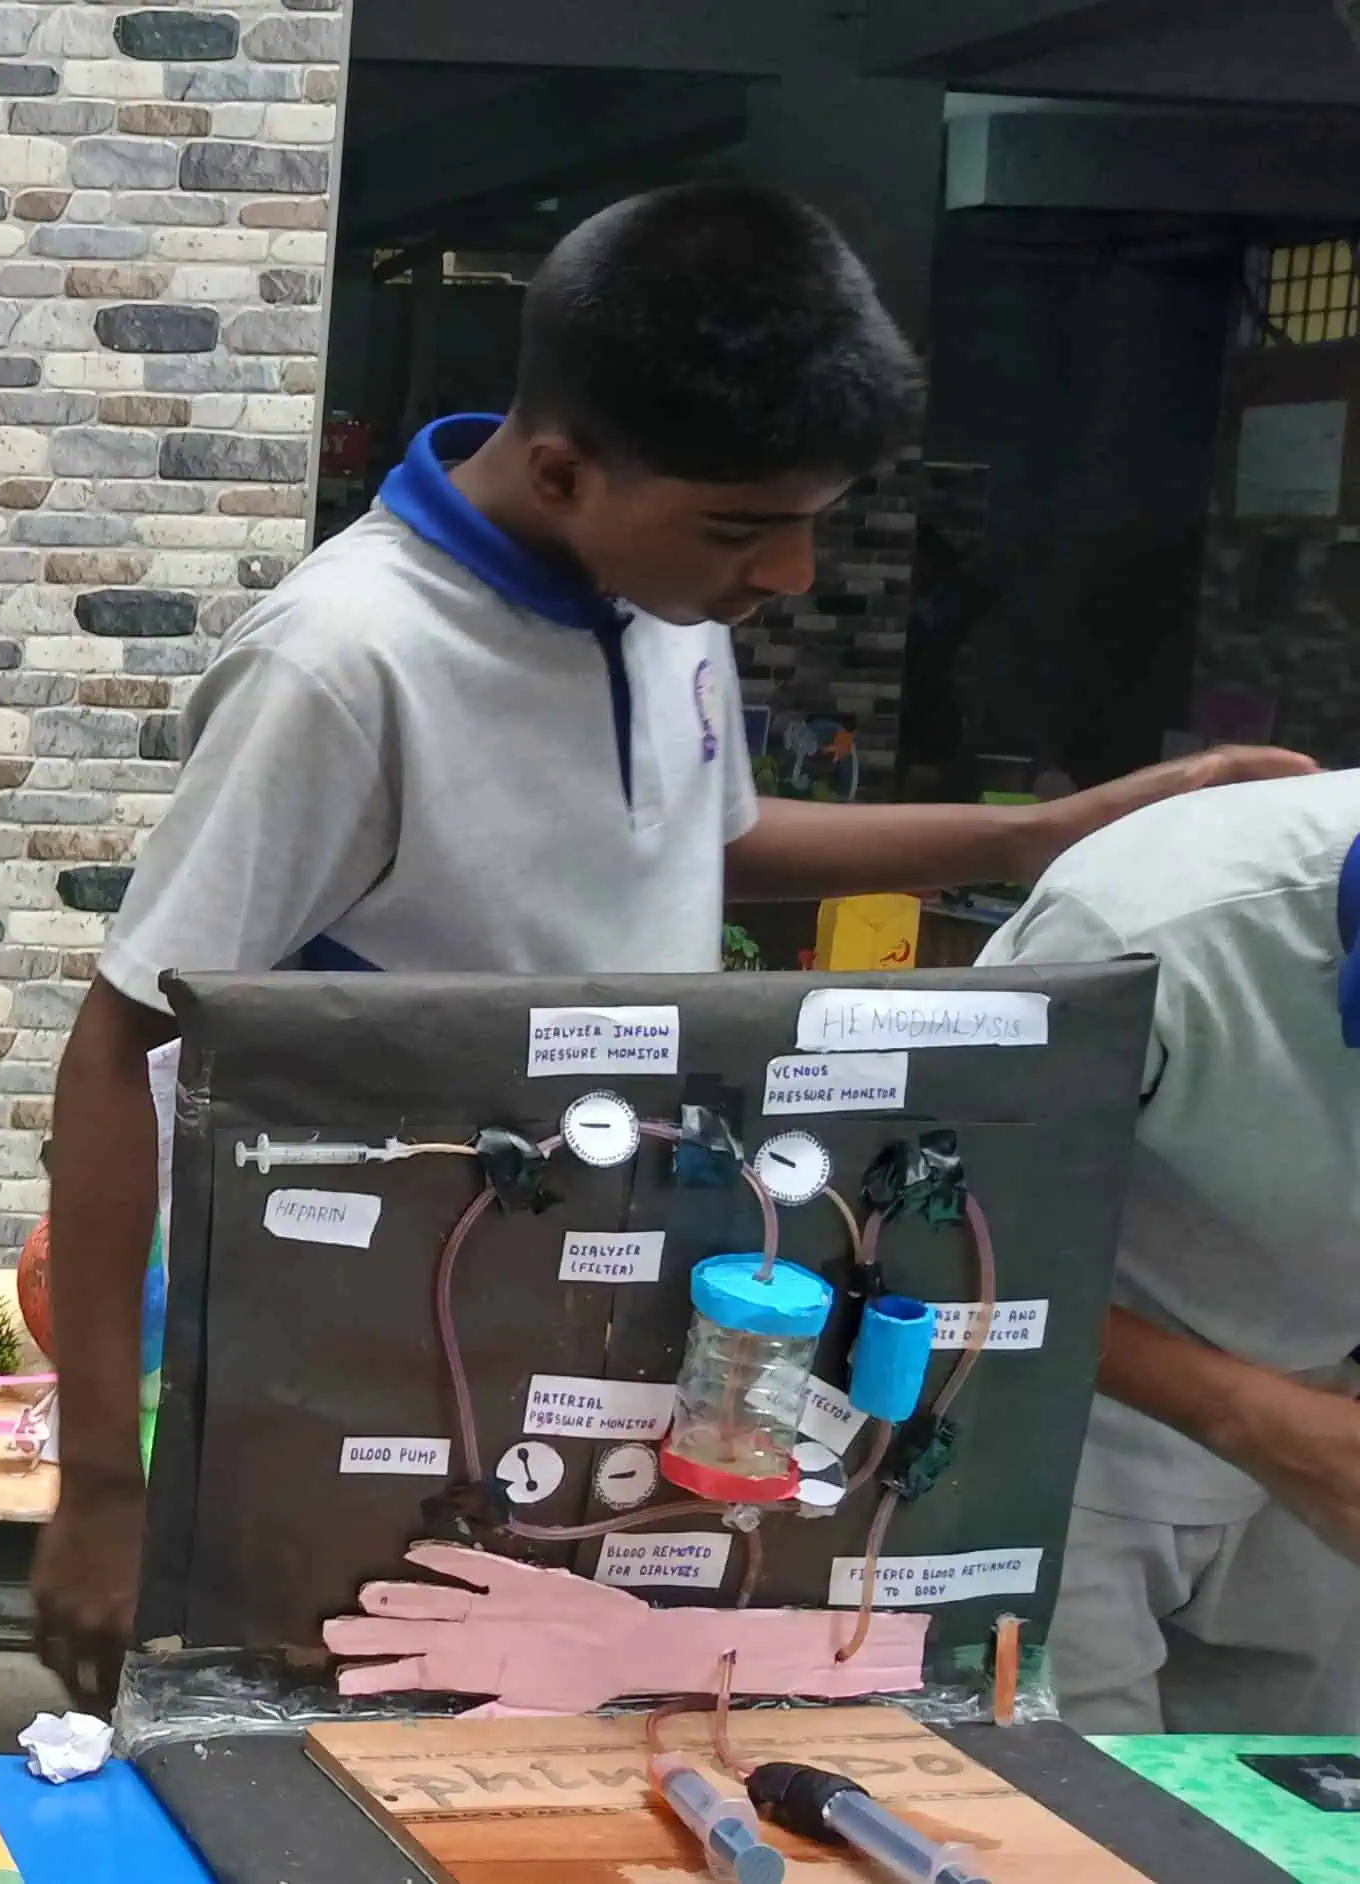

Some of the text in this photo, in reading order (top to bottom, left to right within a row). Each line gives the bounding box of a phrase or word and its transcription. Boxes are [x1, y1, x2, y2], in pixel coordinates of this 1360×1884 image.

[822, 1002, 1024, 1040] HEMODIALYSIS
[613, 1024, 670, 1039] INFLOW
[534, 1047, 670, 1063] PRESSURE MONITOR
[771, 1064, 829, 1080] VENOUS
[768, 1087, 897, 1104] PRESSURE MONITOR
[276, 1198, 347, 1224] HEPARIN
[569, 1262, 634, 1277] (FILTER)
[1008, 1309, 1038, 1323] AND
[963, 1327, 1030, 1342] DECTOR
[533, 1390, 604, 1410] ARTERIAL
[600, 1416, 657, 1431] MONITOR
[350, 1446, 438, 1465] BLOOD PUMP
[607, 1544, 646, 1560] BLOOD
[607, 1563, 632, 1578] FOR
[850, 1559, 1022, 1582] FITERED BLOOD RETURNED
[883, 1583, 948, 1598] TO BODY
